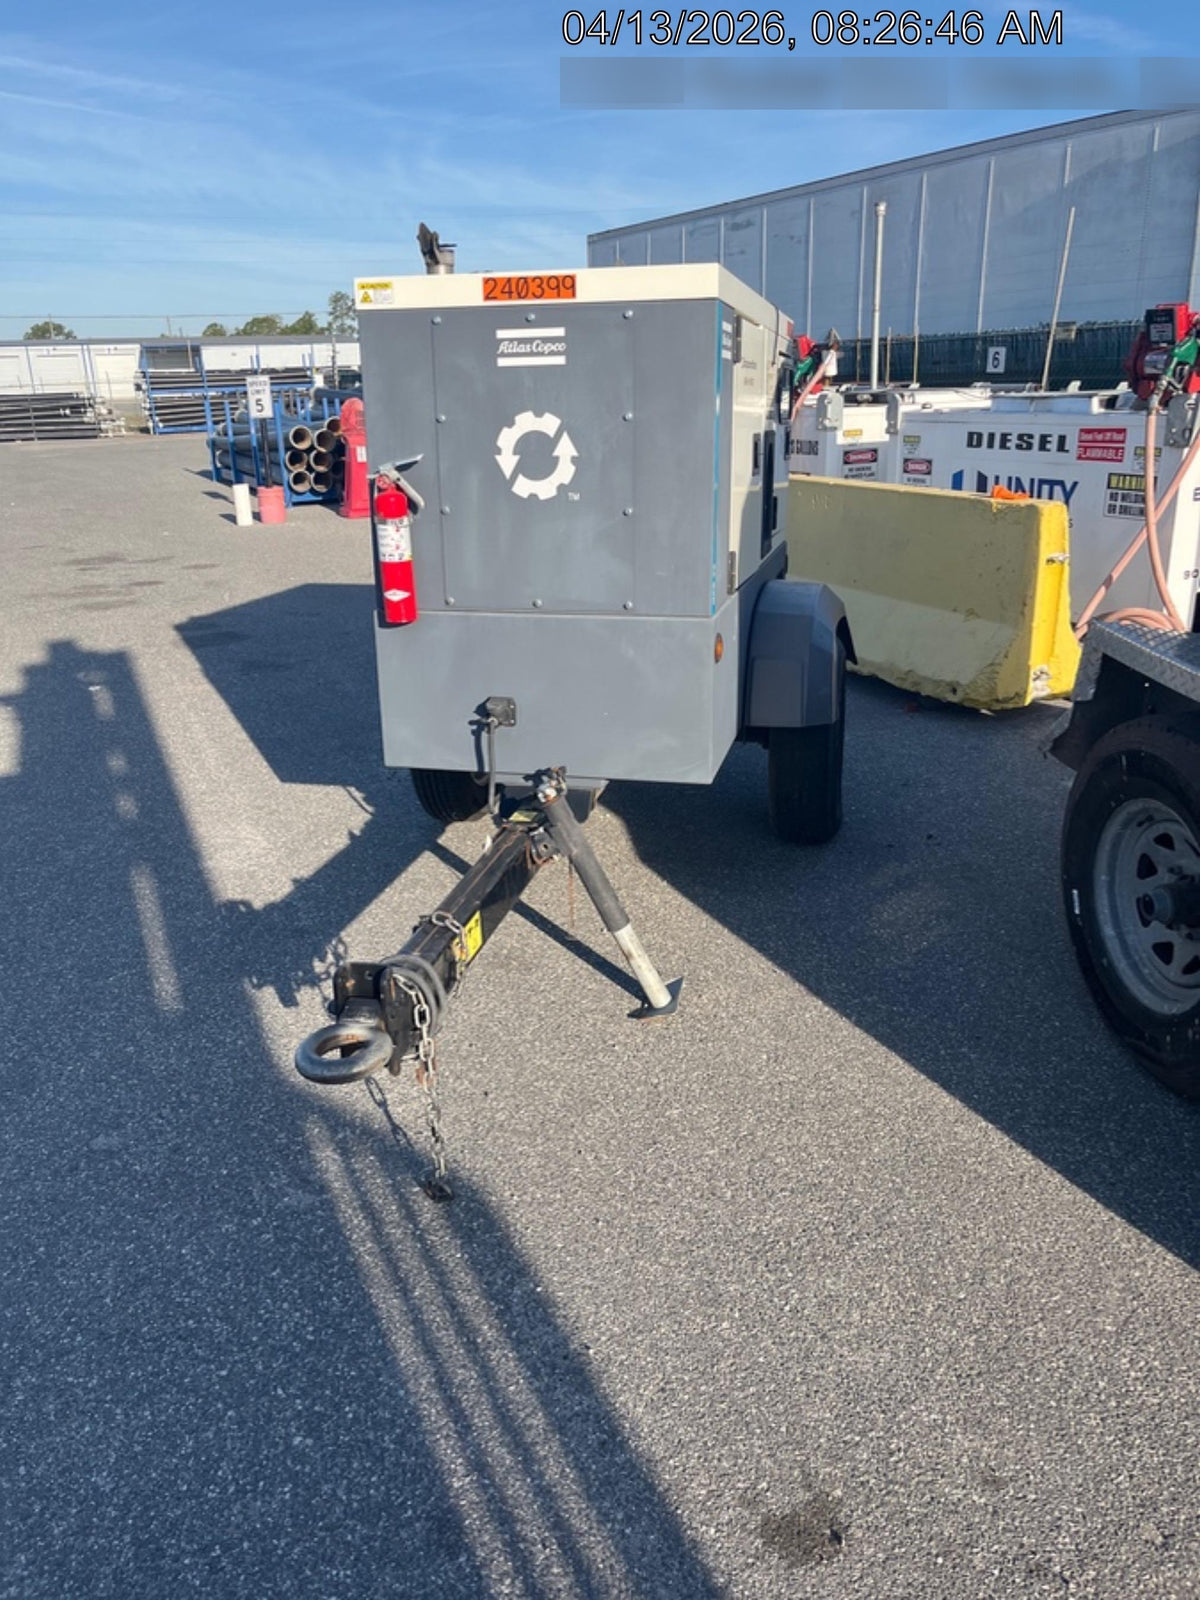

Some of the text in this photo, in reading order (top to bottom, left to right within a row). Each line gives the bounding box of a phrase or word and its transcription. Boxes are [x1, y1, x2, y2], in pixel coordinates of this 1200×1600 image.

[484, 275, 576, 300] 240399
[497, 339, 566, 354] Atlas Copco
[992, 351, 1000, 369] 6
[255, 398, 264, 413] 5
[966, 431, 1070, 453] DIESEL
[1076, 447, 1124, 460] FLAMMABLE
[1110, 475, 1146, 490] WARNIN
